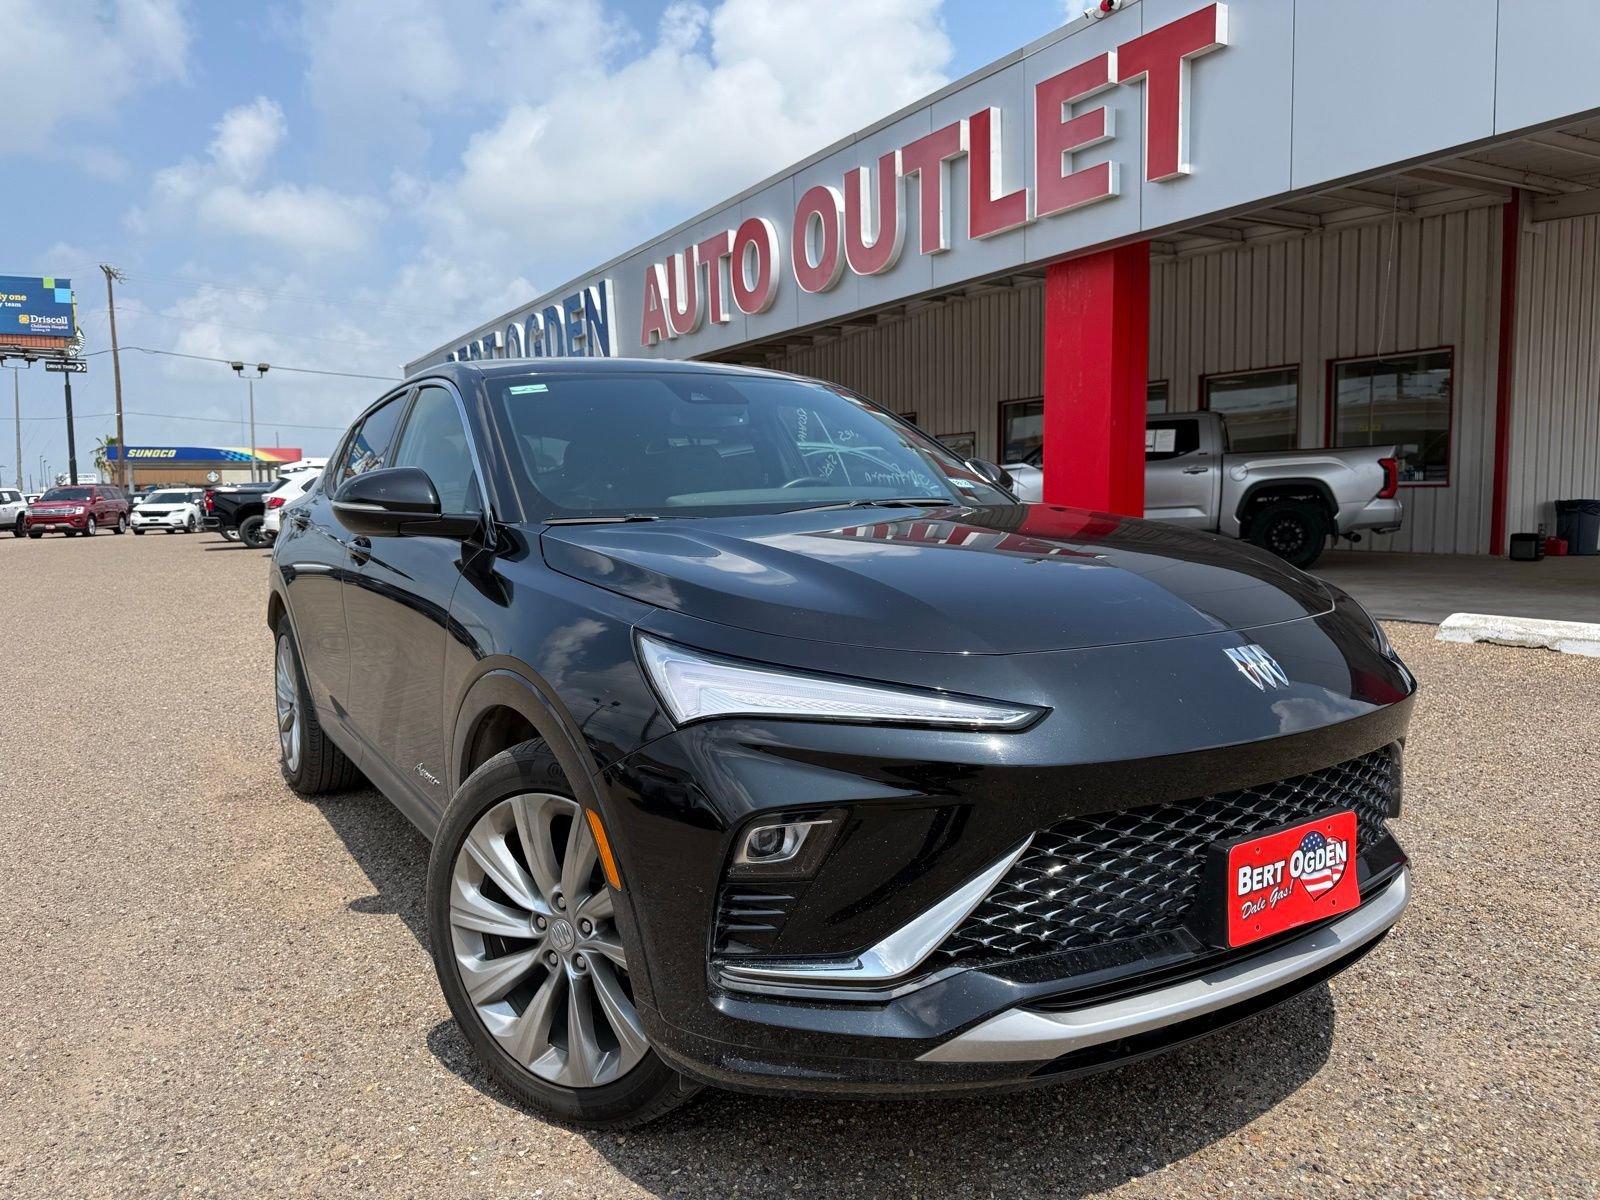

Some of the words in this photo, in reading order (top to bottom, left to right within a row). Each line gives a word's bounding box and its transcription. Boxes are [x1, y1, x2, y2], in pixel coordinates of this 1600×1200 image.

[505, 278, 617, 358] OGDEN
[640, 217, 779, 347] AUTO
[792, 2, 1229, 293] OUTLET
[30, 315, 68, 324] Driscoll
[128, 449, 176, 457] SUNOCO
[1237, 860, 1286, 896] BERT
[1290, 841, 1347, 878] OGDEN
[1241, 898, 1266, 919] Dale
